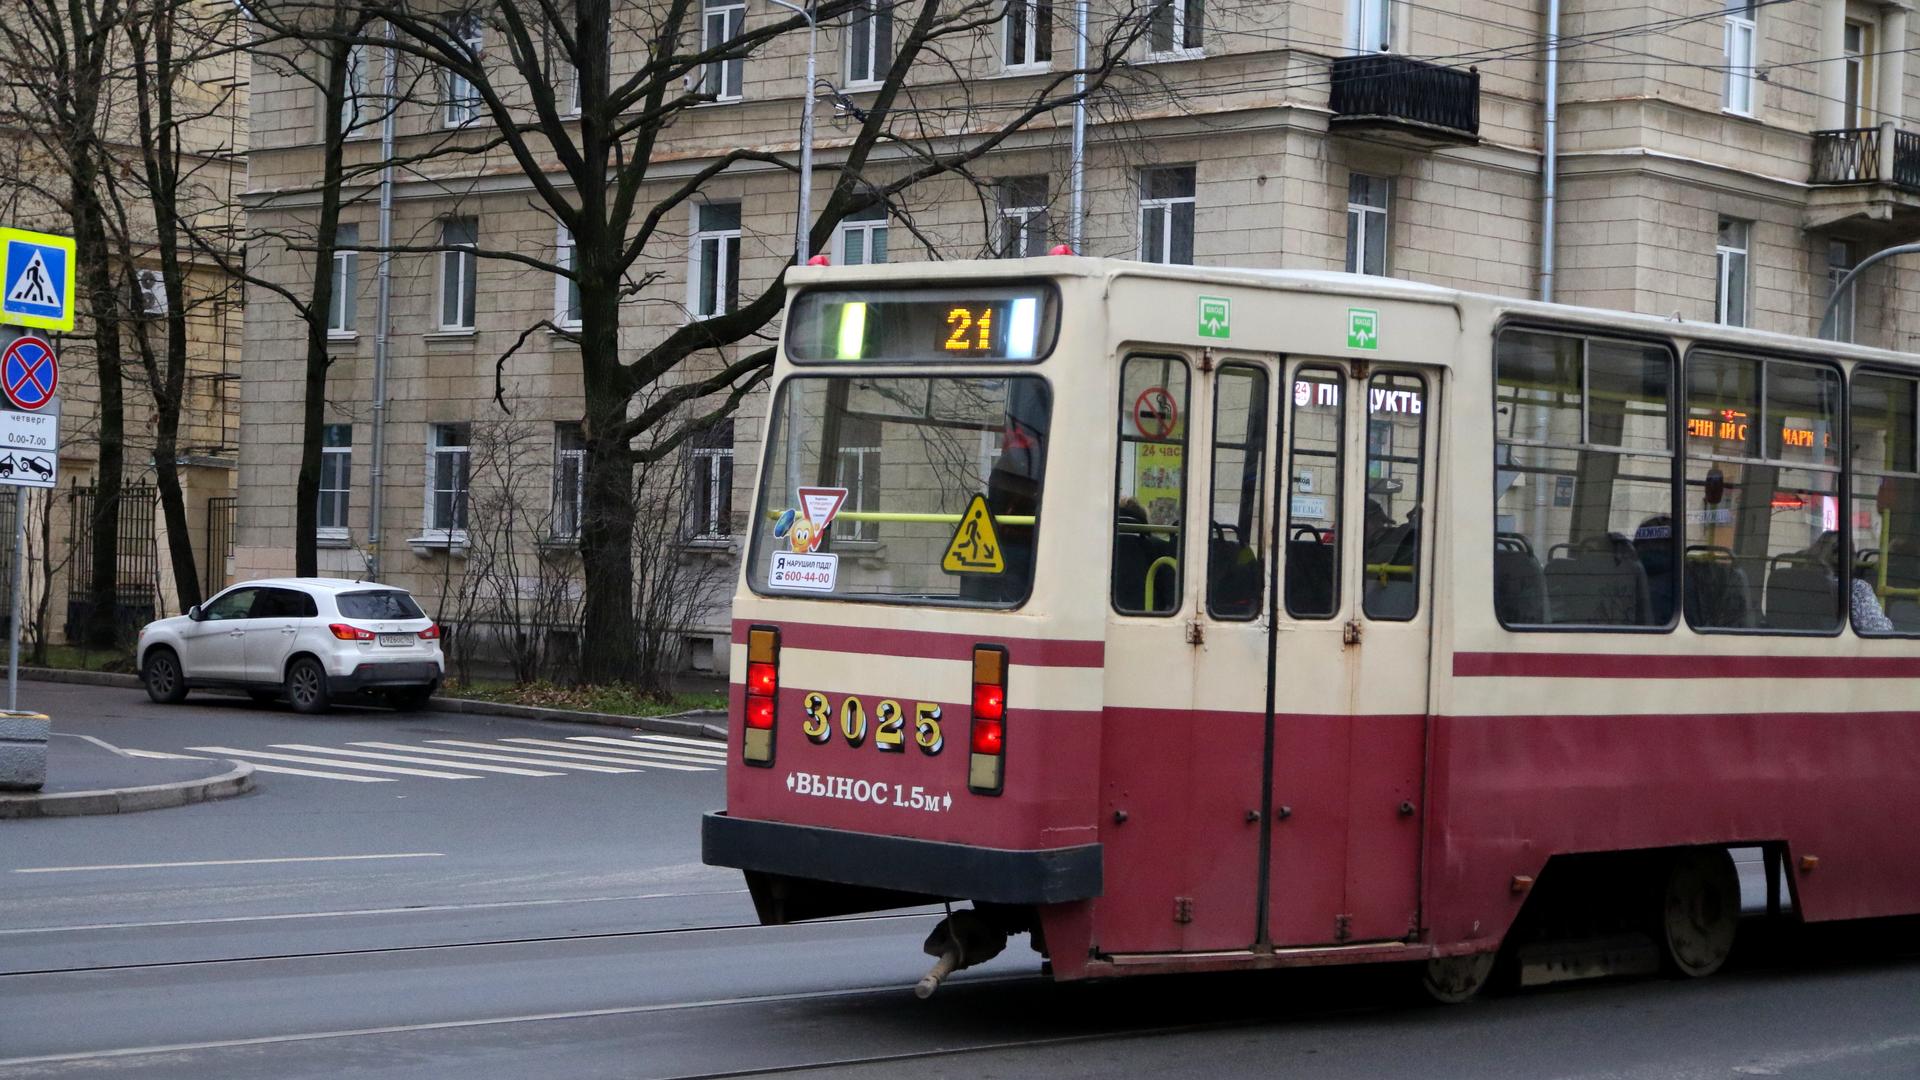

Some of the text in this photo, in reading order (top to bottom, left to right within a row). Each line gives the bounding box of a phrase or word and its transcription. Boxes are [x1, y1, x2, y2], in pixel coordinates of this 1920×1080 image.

[945, 308, 992, 350] 21
[10, 415, 47, 425] четверг
[8, 432, 47, 446] 0.00-7.00
[776, 557, 786, 570] Я
[786, 559, 816, 569] НАРУШИЛ
[784, 571, 830, 584] 600-44-00
[803, 692, 944, 756] 3025
[795, 771, 940, 813] ВЫНОС 1.5м
